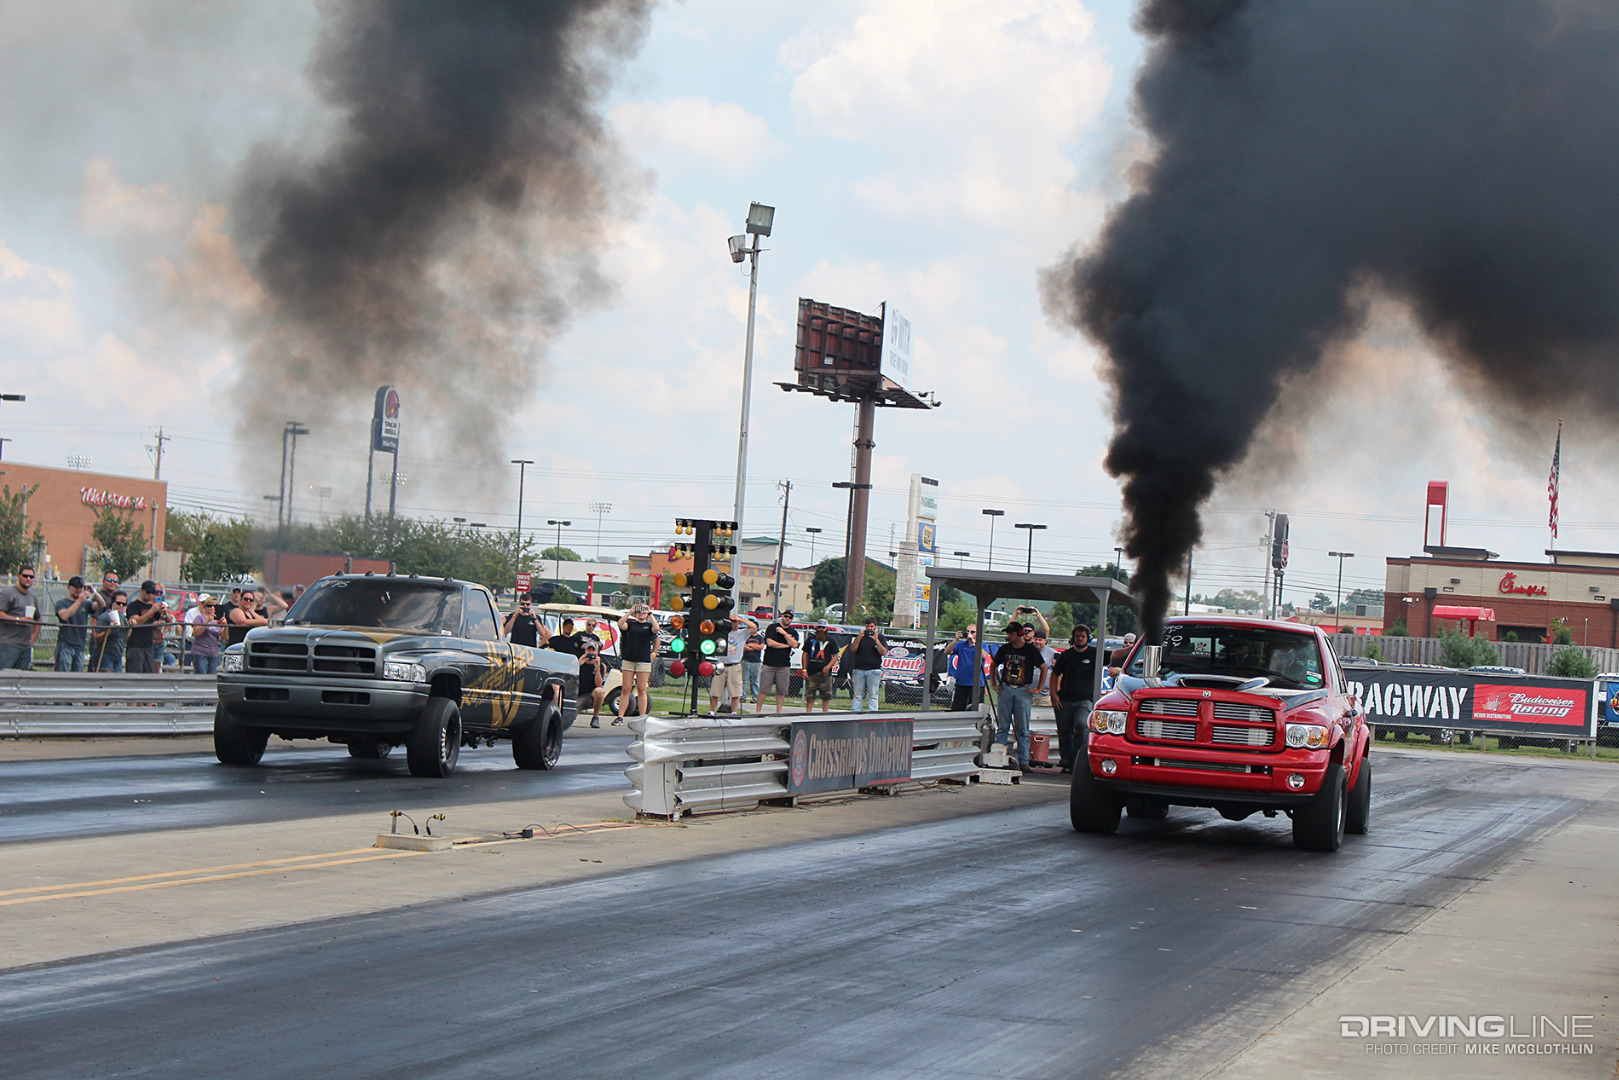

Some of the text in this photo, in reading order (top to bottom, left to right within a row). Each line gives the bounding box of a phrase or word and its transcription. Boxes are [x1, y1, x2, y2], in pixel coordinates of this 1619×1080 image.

[384, 421, 398, 429] TACO
[384, 428, 397, 436] BELL
[923, 536, 932, 545] BUY
[882, 658, 922, 670] UMMIT
[1347, 681, 1468, 720] RAGWAY
[1508, 693, 1575, 706] Budweiser
